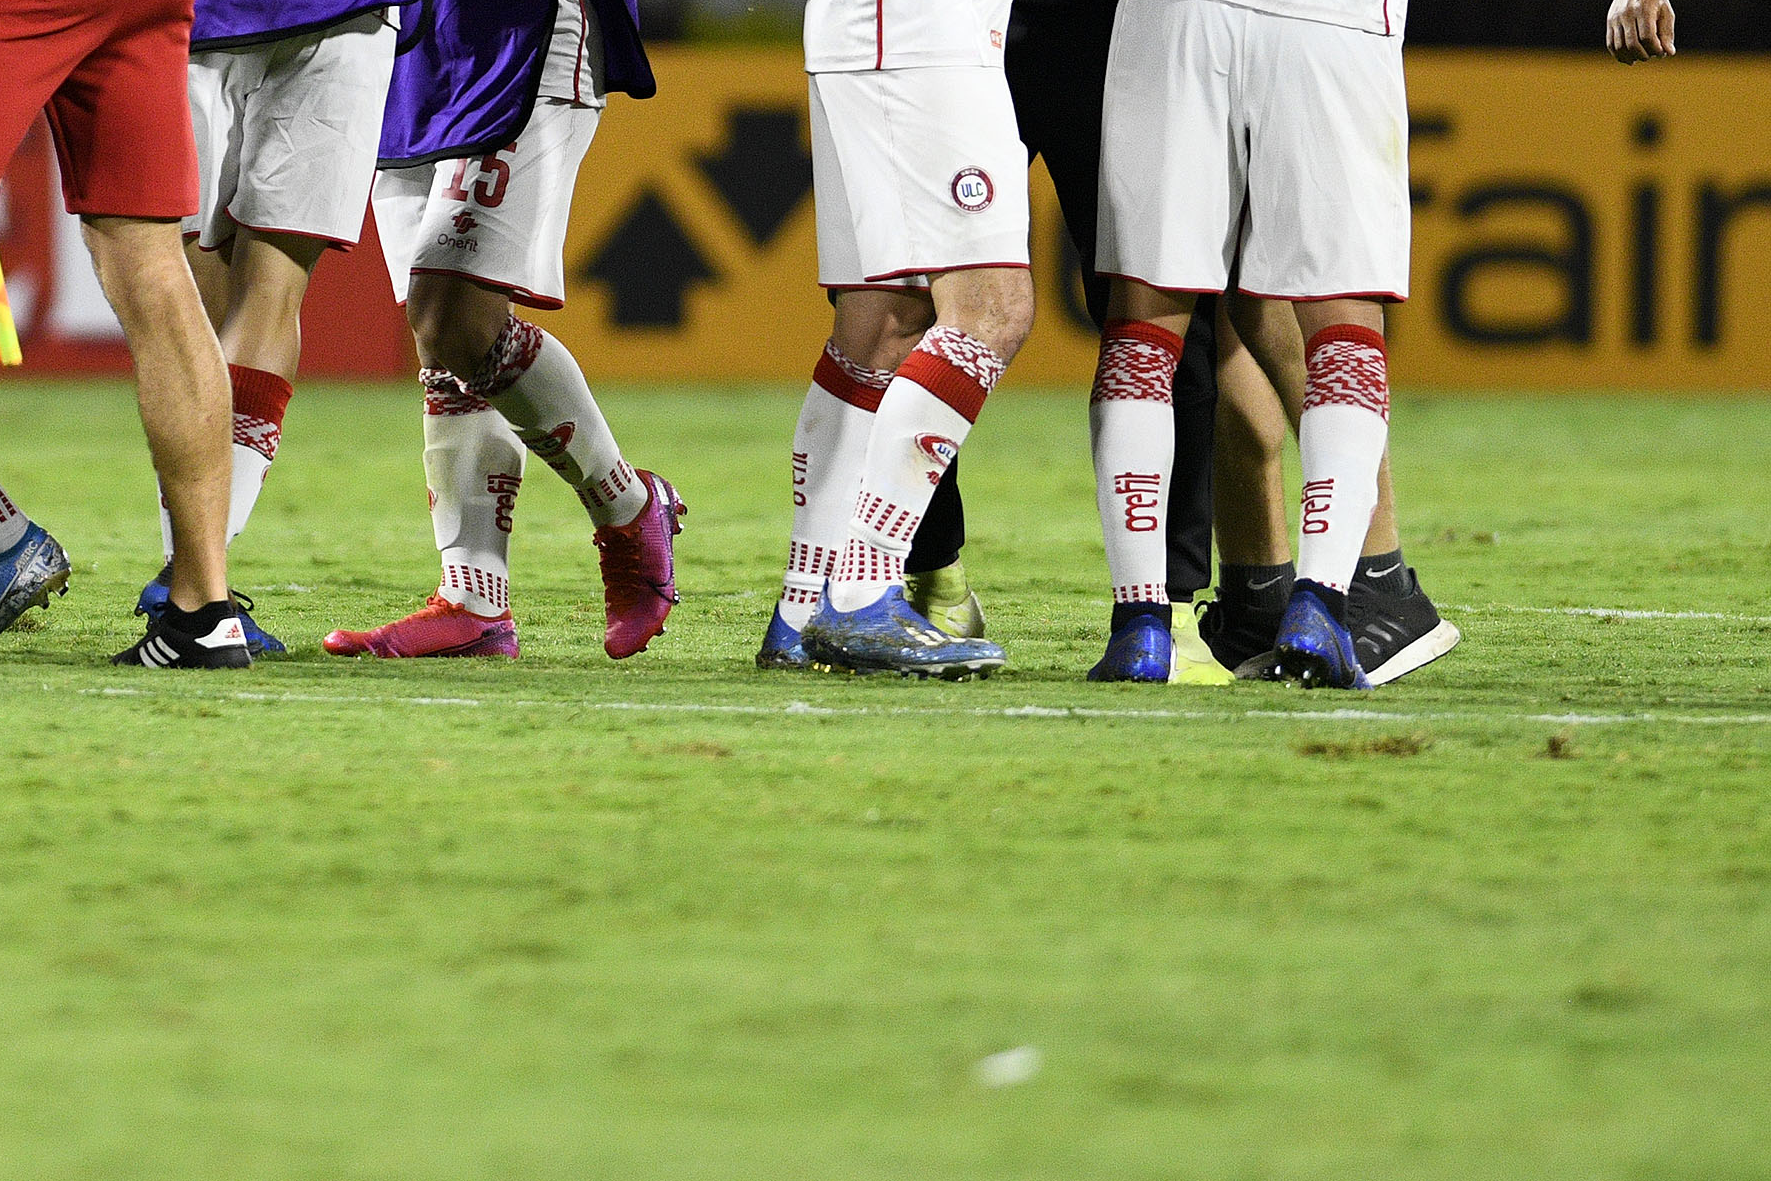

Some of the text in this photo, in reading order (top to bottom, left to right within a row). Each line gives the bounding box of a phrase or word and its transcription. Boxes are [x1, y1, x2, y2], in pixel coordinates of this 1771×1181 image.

[441, 141, 517, 208] 15
[961, 182, 984, 198] ULC
[437, 233, 478, 252] Onefit
